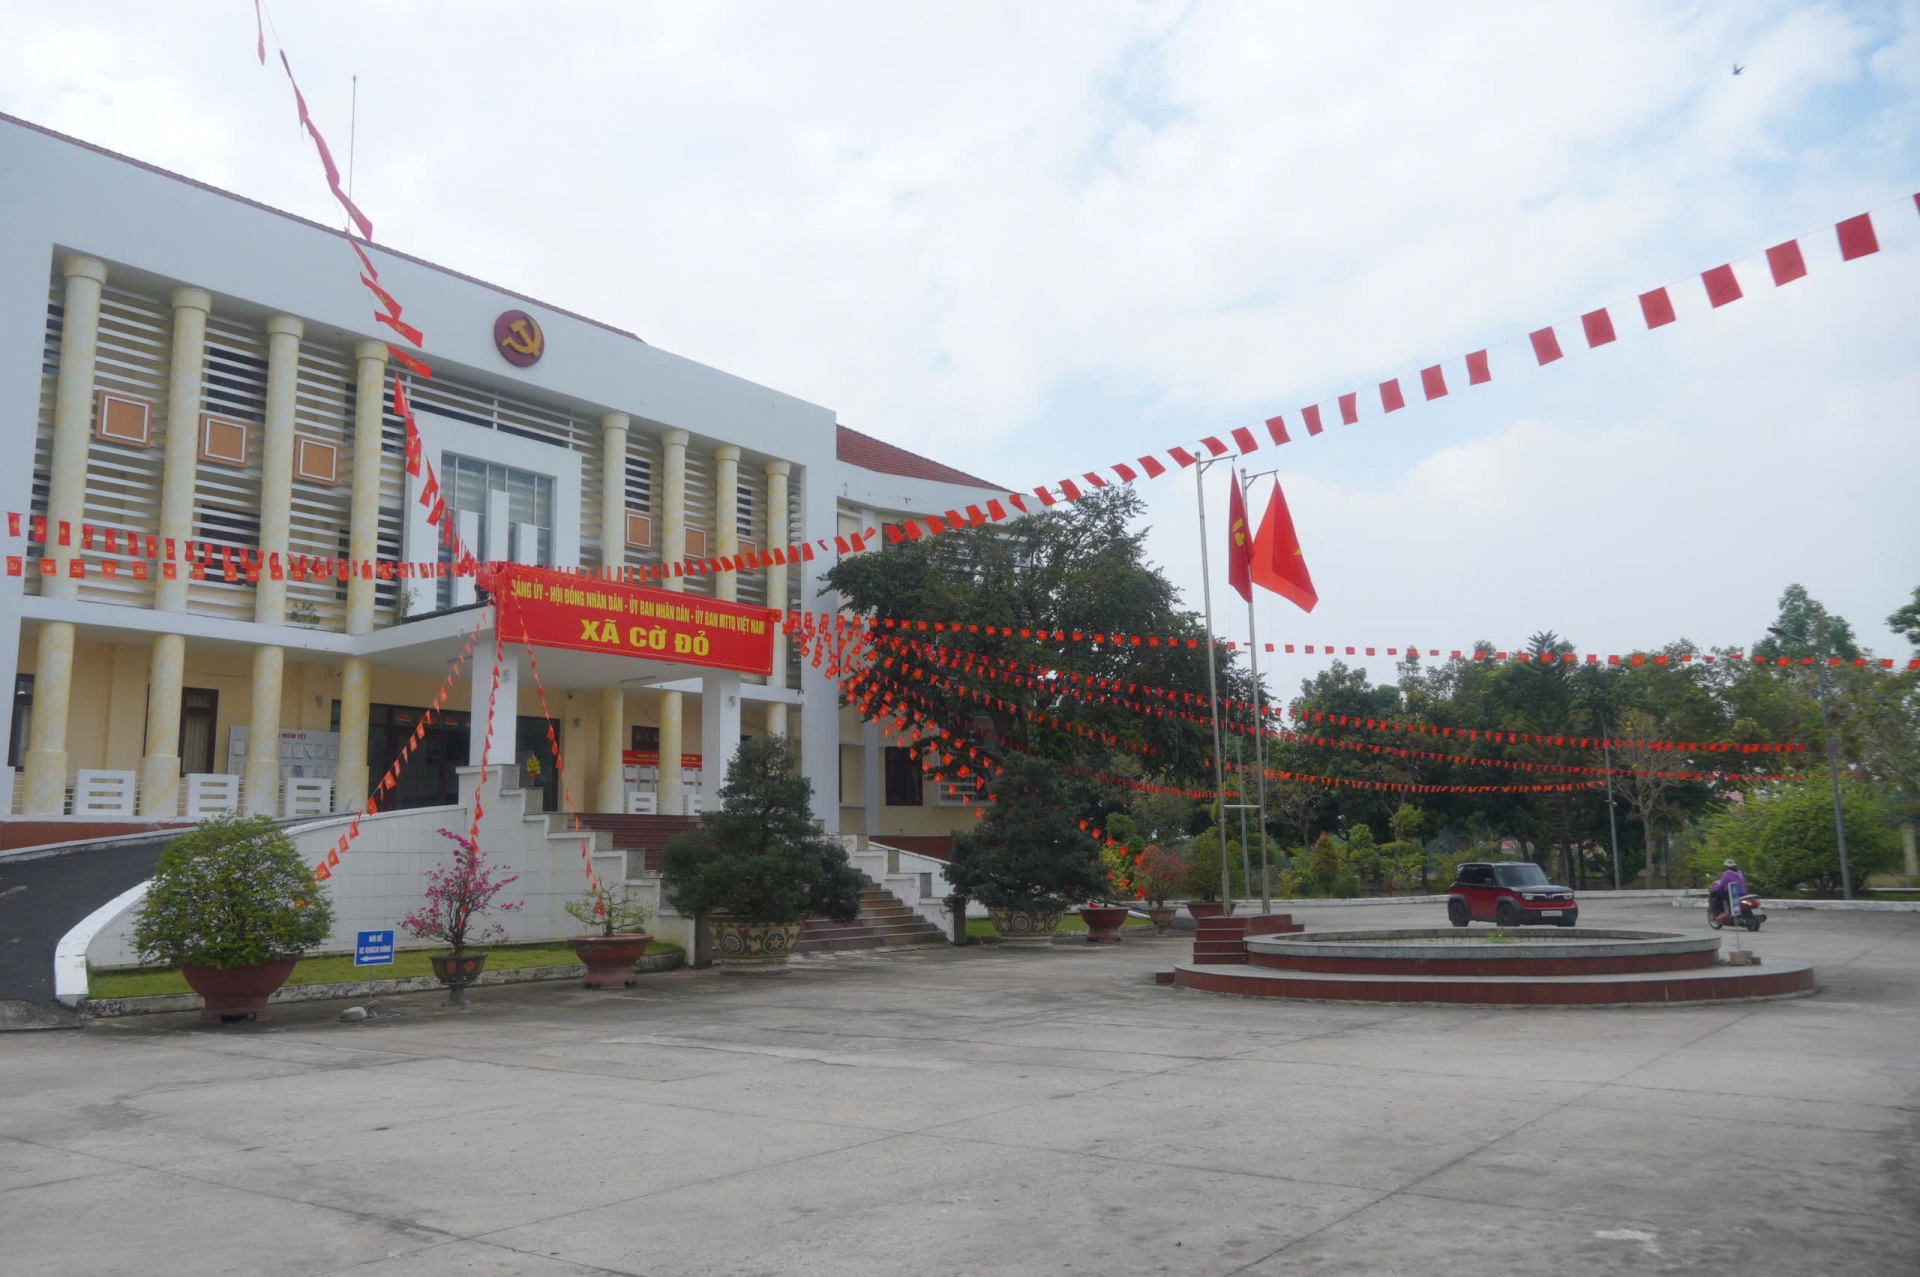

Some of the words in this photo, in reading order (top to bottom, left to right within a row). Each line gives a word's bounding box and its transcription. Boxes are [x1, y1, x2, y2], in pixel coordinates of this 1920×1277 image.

[533, 577, 544, 600] ỦY
[550, 583, 563, 606] HỘI
[586, 590, 607, 610] NHÂN
[608, 592, 623, 613] DÂN
[629, 593, 639, 614] ỦY
[640, 600, 655, 618] BAN
[656, 601, 675, 620] NHÂN
[676, 604, 690, 623] DÂN
[695, 604, 703, 624] ỦY
[705, 611, 718, 628] BAN
[719, 613, 736, 632] MTTQ
[737, 615, 749, 635] VIỆT
[751, 620, 764, 635] NAM
[580, 618, 621, 645] XÃ
[629, 624, 667, 650] CỜ
[674, 630, 710, 656] ĐỎ
